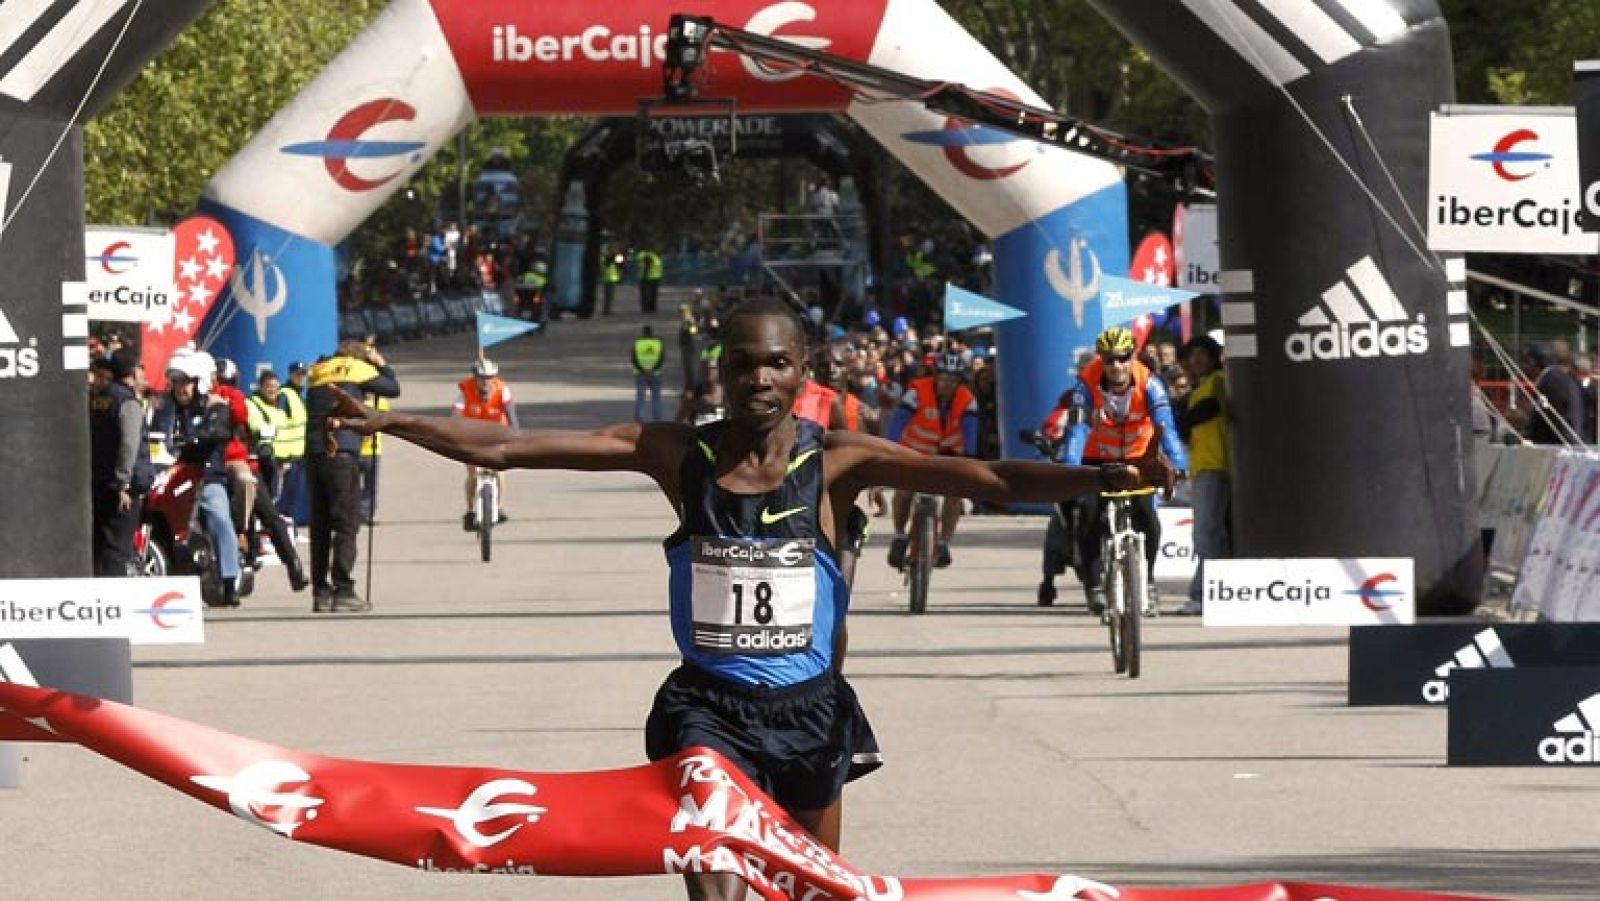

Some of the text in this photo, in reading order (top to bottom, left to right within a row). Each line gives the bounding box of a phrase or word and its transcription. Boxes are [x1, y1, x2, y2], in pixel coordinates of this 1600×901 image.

[1285, 321, 1430, 362] adidas
[732, 581, 774, 624] 18
[1208, 579, 1331, 606] iberCaja
[0, 599, 122, 626] iberCaja
[737, 629, 807, 648] adidas
